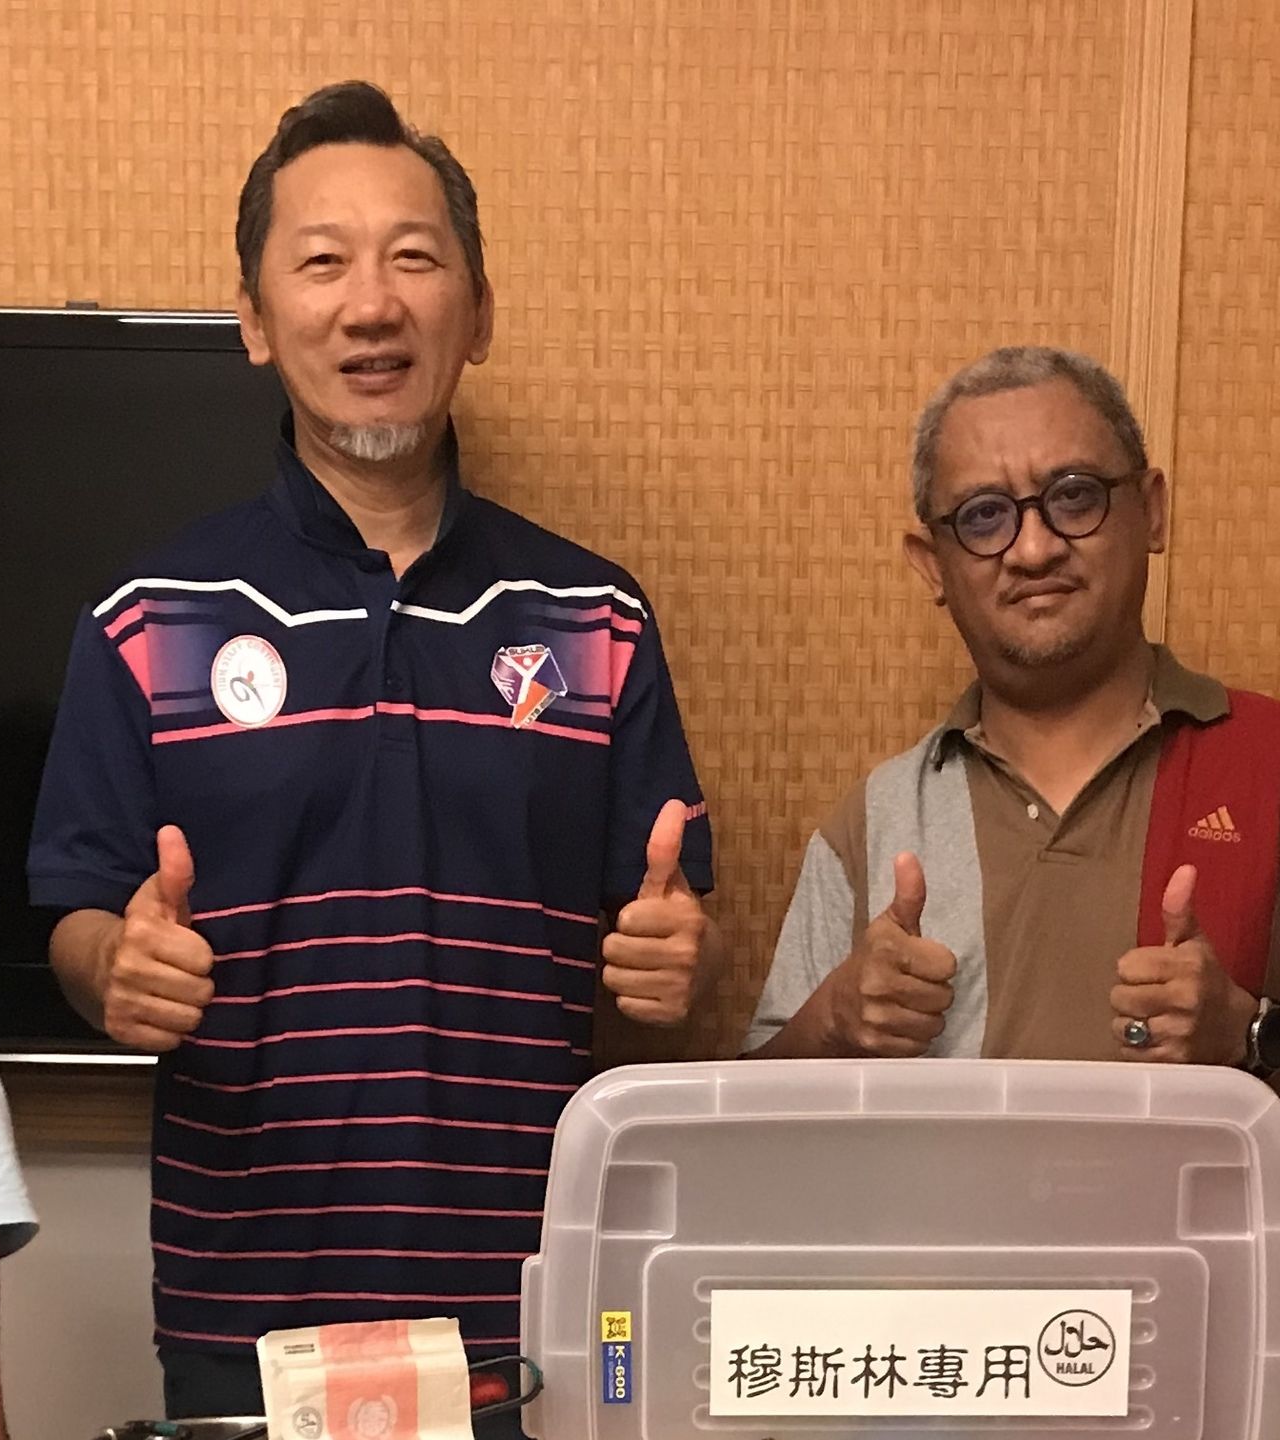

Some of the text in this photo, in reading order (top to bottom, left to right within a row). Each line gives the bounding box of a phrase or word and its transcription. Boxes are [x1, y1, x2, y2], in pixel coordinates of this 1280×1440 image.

[1188, 827, 1241, 843] adidas
[1045, 1319, 1111, 1358] حلال
[727, 1342, 1032, 1400] 穆斯林專用
[1056, 1361, 1096, 1375] HALAL
